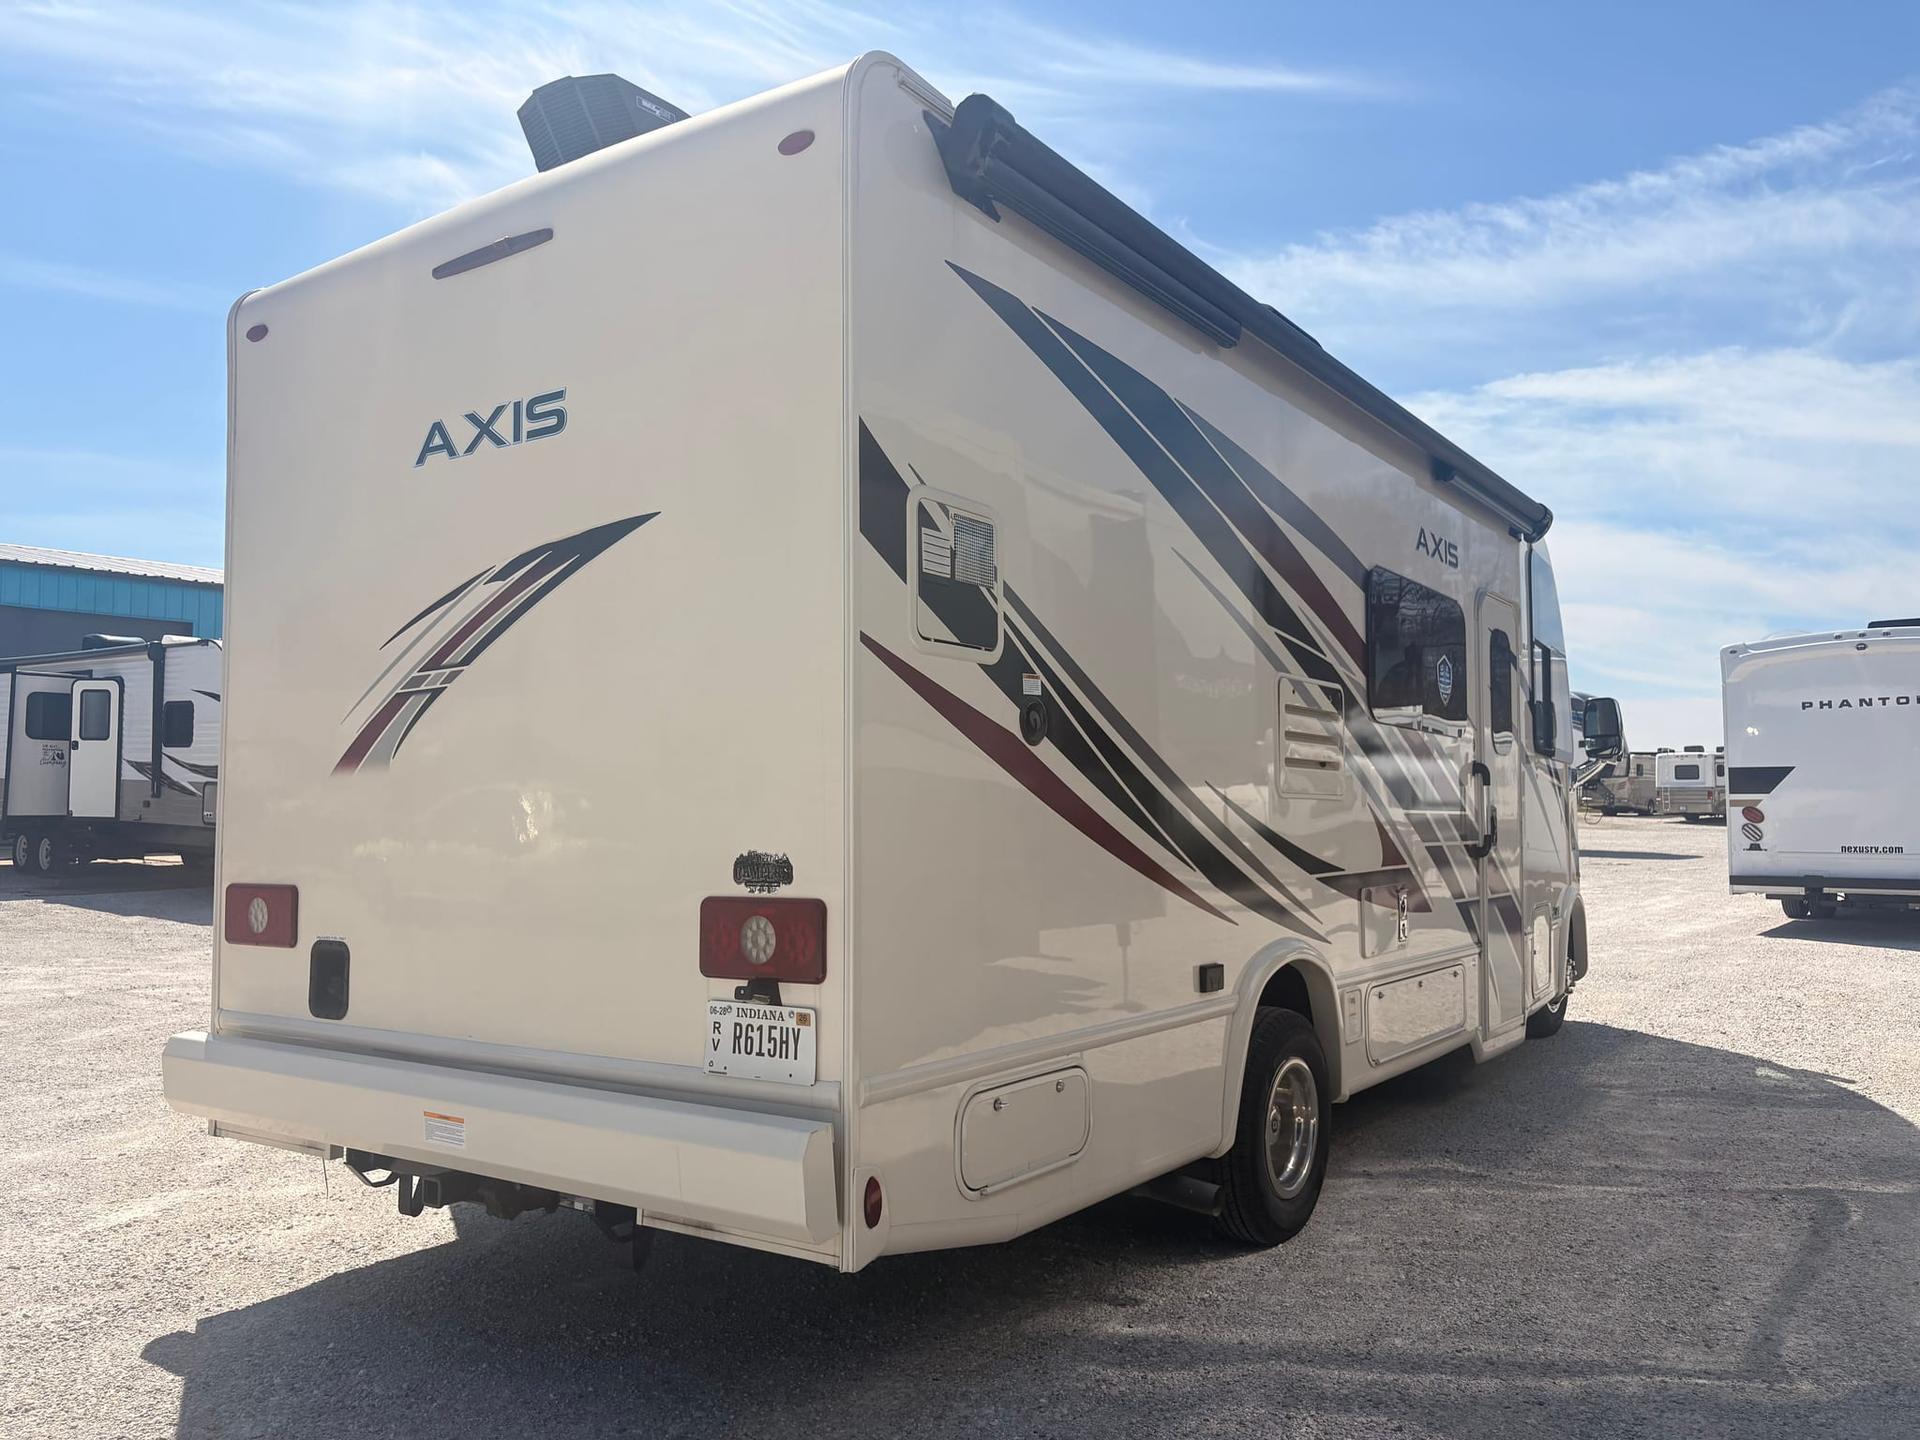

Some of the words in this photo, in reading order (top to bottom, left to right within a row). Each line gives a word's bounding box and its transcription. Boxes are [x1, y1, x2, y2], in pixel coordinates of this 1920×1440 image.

[414, 386, 568, 468] AXIS
[1416, 526, 1459, 569] AXIS
[1840, 845, 1904, 854] nexusrv.com
[736, 1007, 784, 1022] INDIANA
[732, 1021, 801, 1061] R615HY
